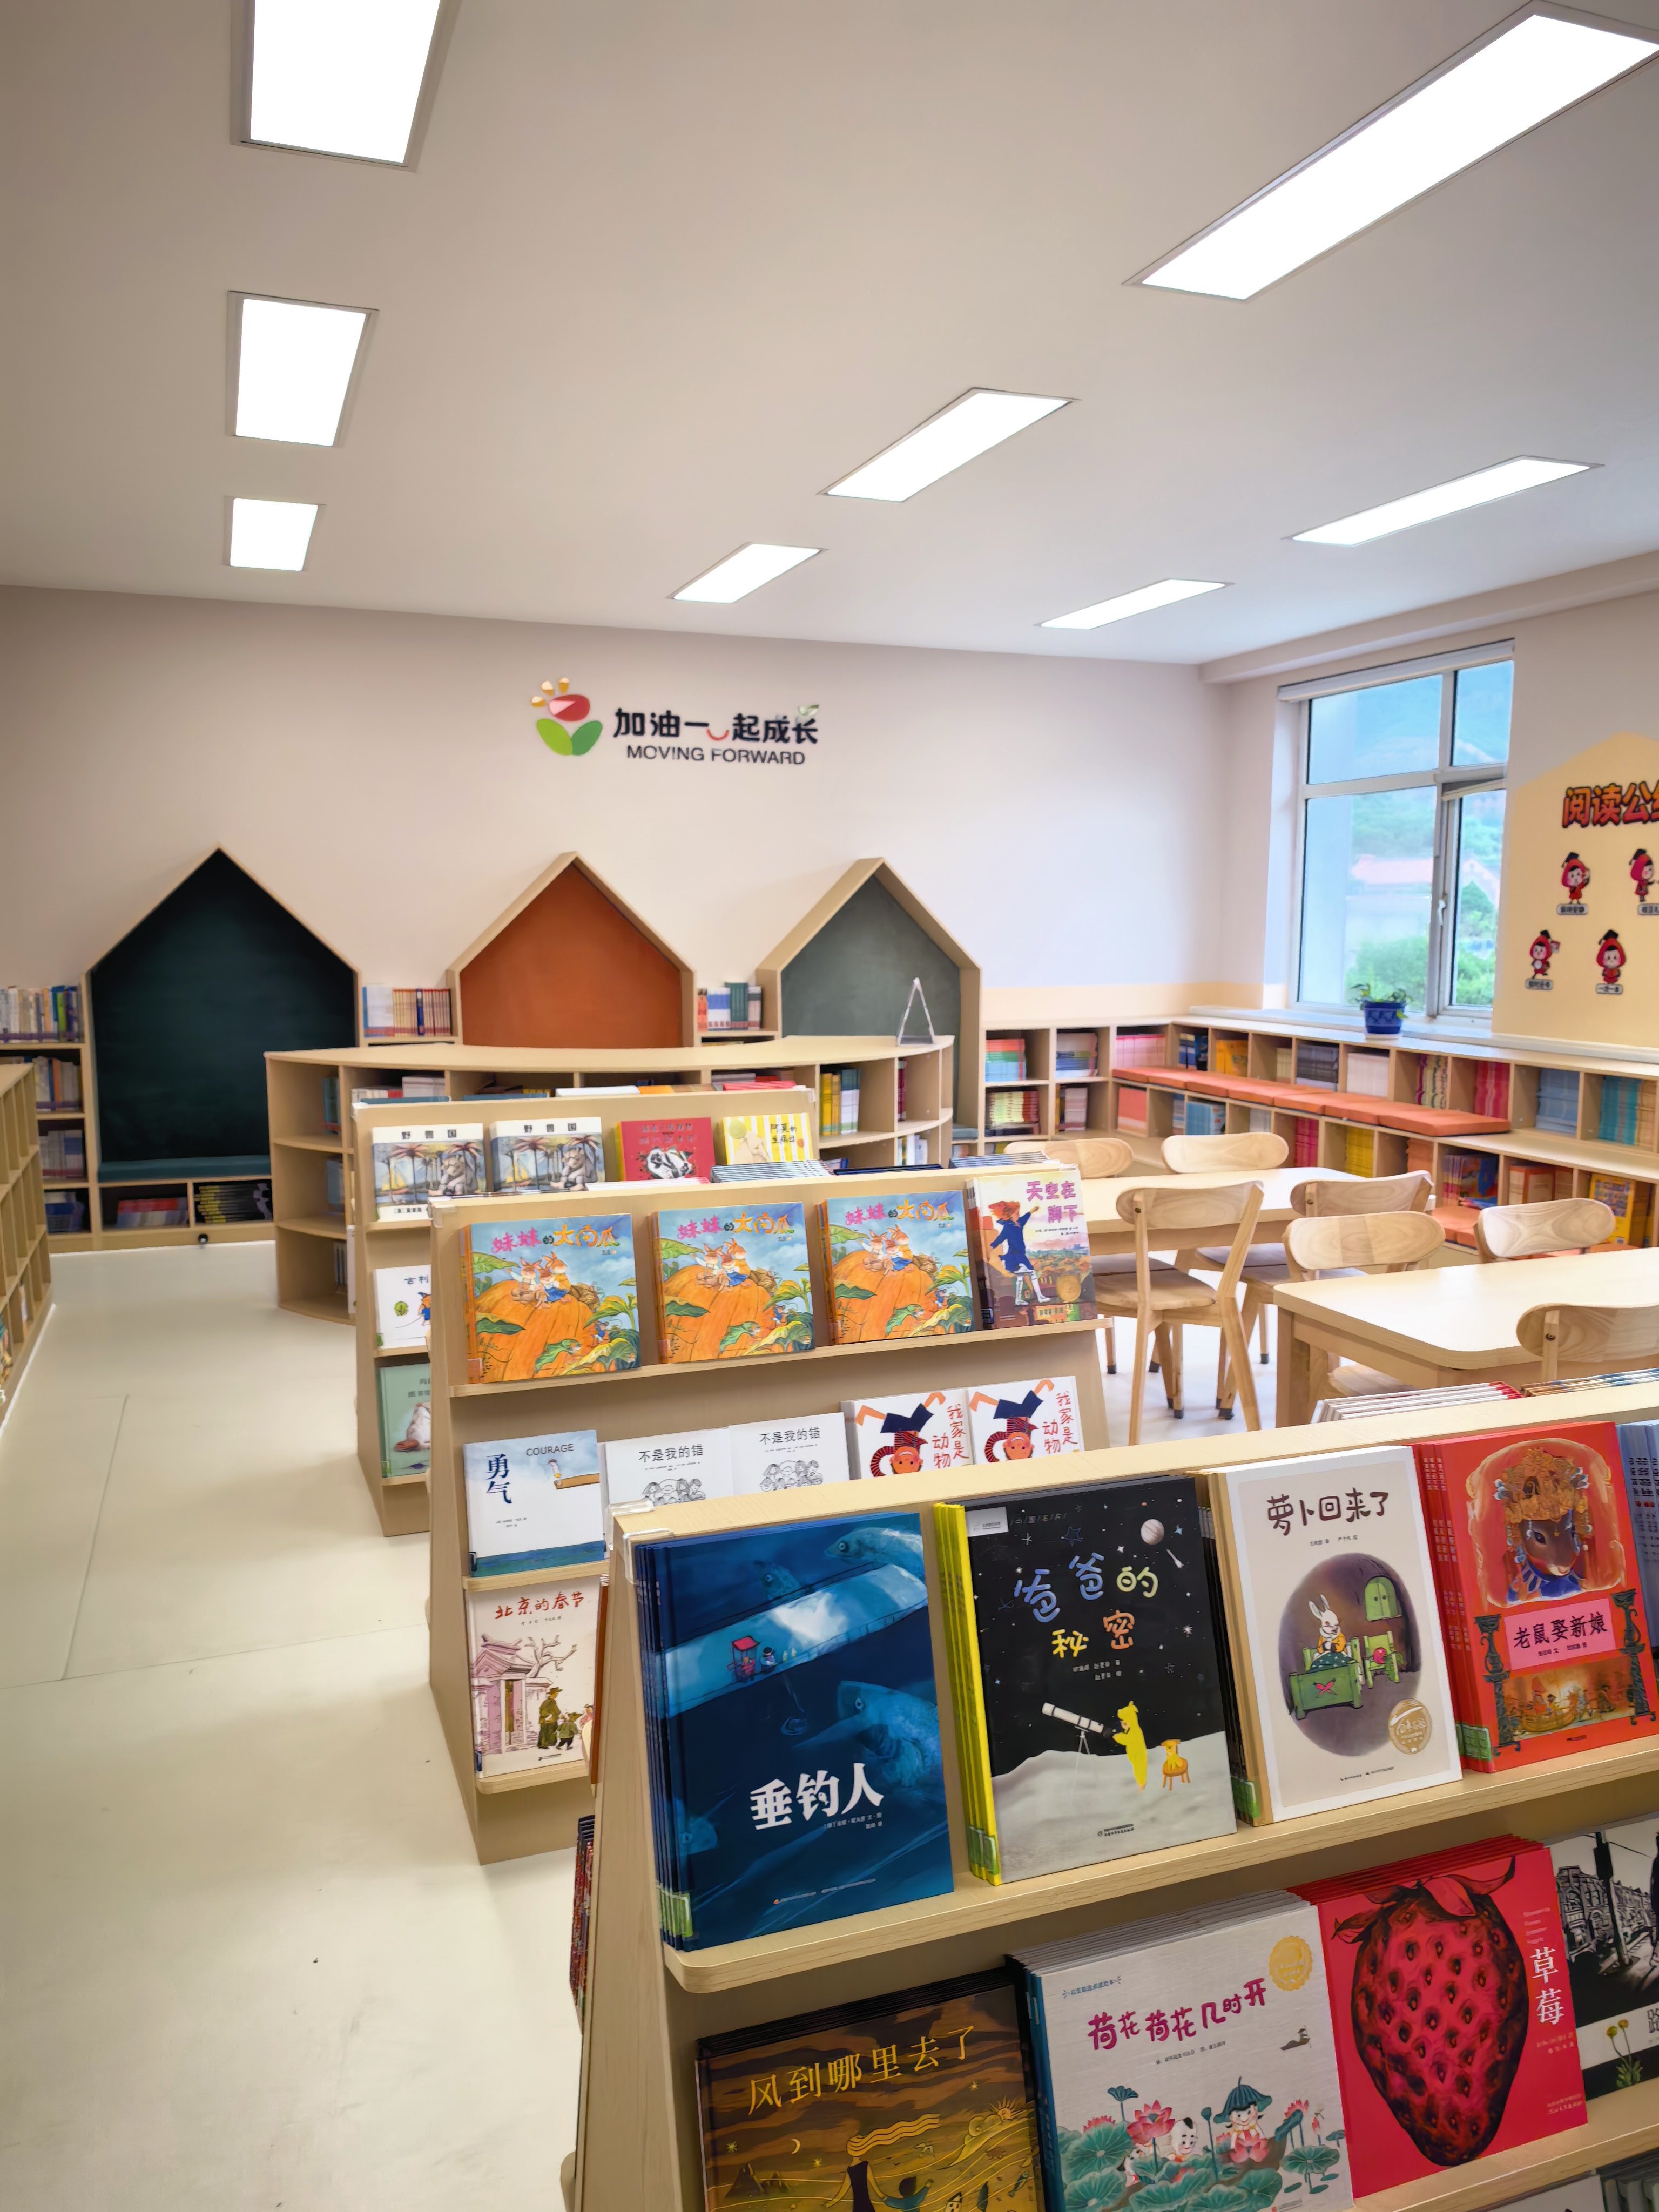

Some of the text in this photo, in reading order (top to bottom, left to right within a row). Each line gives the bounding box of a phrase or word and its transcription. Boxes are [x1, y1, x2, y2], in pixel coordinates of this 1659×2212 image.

[613, 707, 819, 745] 加油一起成长
[626, 745, 806, 765] MOVING FORWARD
[1561, 779, 1659, 830] 阅读公
[677, 1211, 794, 1240] 妹妹的大南瓜
[845, 1198, 954, 1226] 妹妹的大南瓜
[491, 1224, 621, 1253] 妹妹的大南瓜
[759, 1426, 820, 1446] 不是我的错
[947, 1403, 970, 1460] 我家是
[1055, 1390, 1078, 1445] 我家是
[526, 1444, 574, 1456] COURAGE
[638, 1443, 704, 1462] 不是我的错
[932, 1432, 952, 1469] 动物
[1042, 1421, 1061, 1454] 动物
[485, 1453, 512, 1504] 勇气
[1266, 1487, 1390, 1536] 萝卜回来了
[494, 1590, 585, 1620] 北京的春节
[1014, 1552, 1159, 1623] 爸爸的
[1051, 1609, 1135, 1658] 秘密
[1514, 1611, 1608, 1649] 老鼠娶新娘
[749, 1762, 884, 1831] 垂钓人
[1529, 1946, 1566, 2025] 草莓
[1088, 1977, 1267, 2051] 荷花荷花几时开
[747, 2025, 975, 2116] 风到哪里去了
